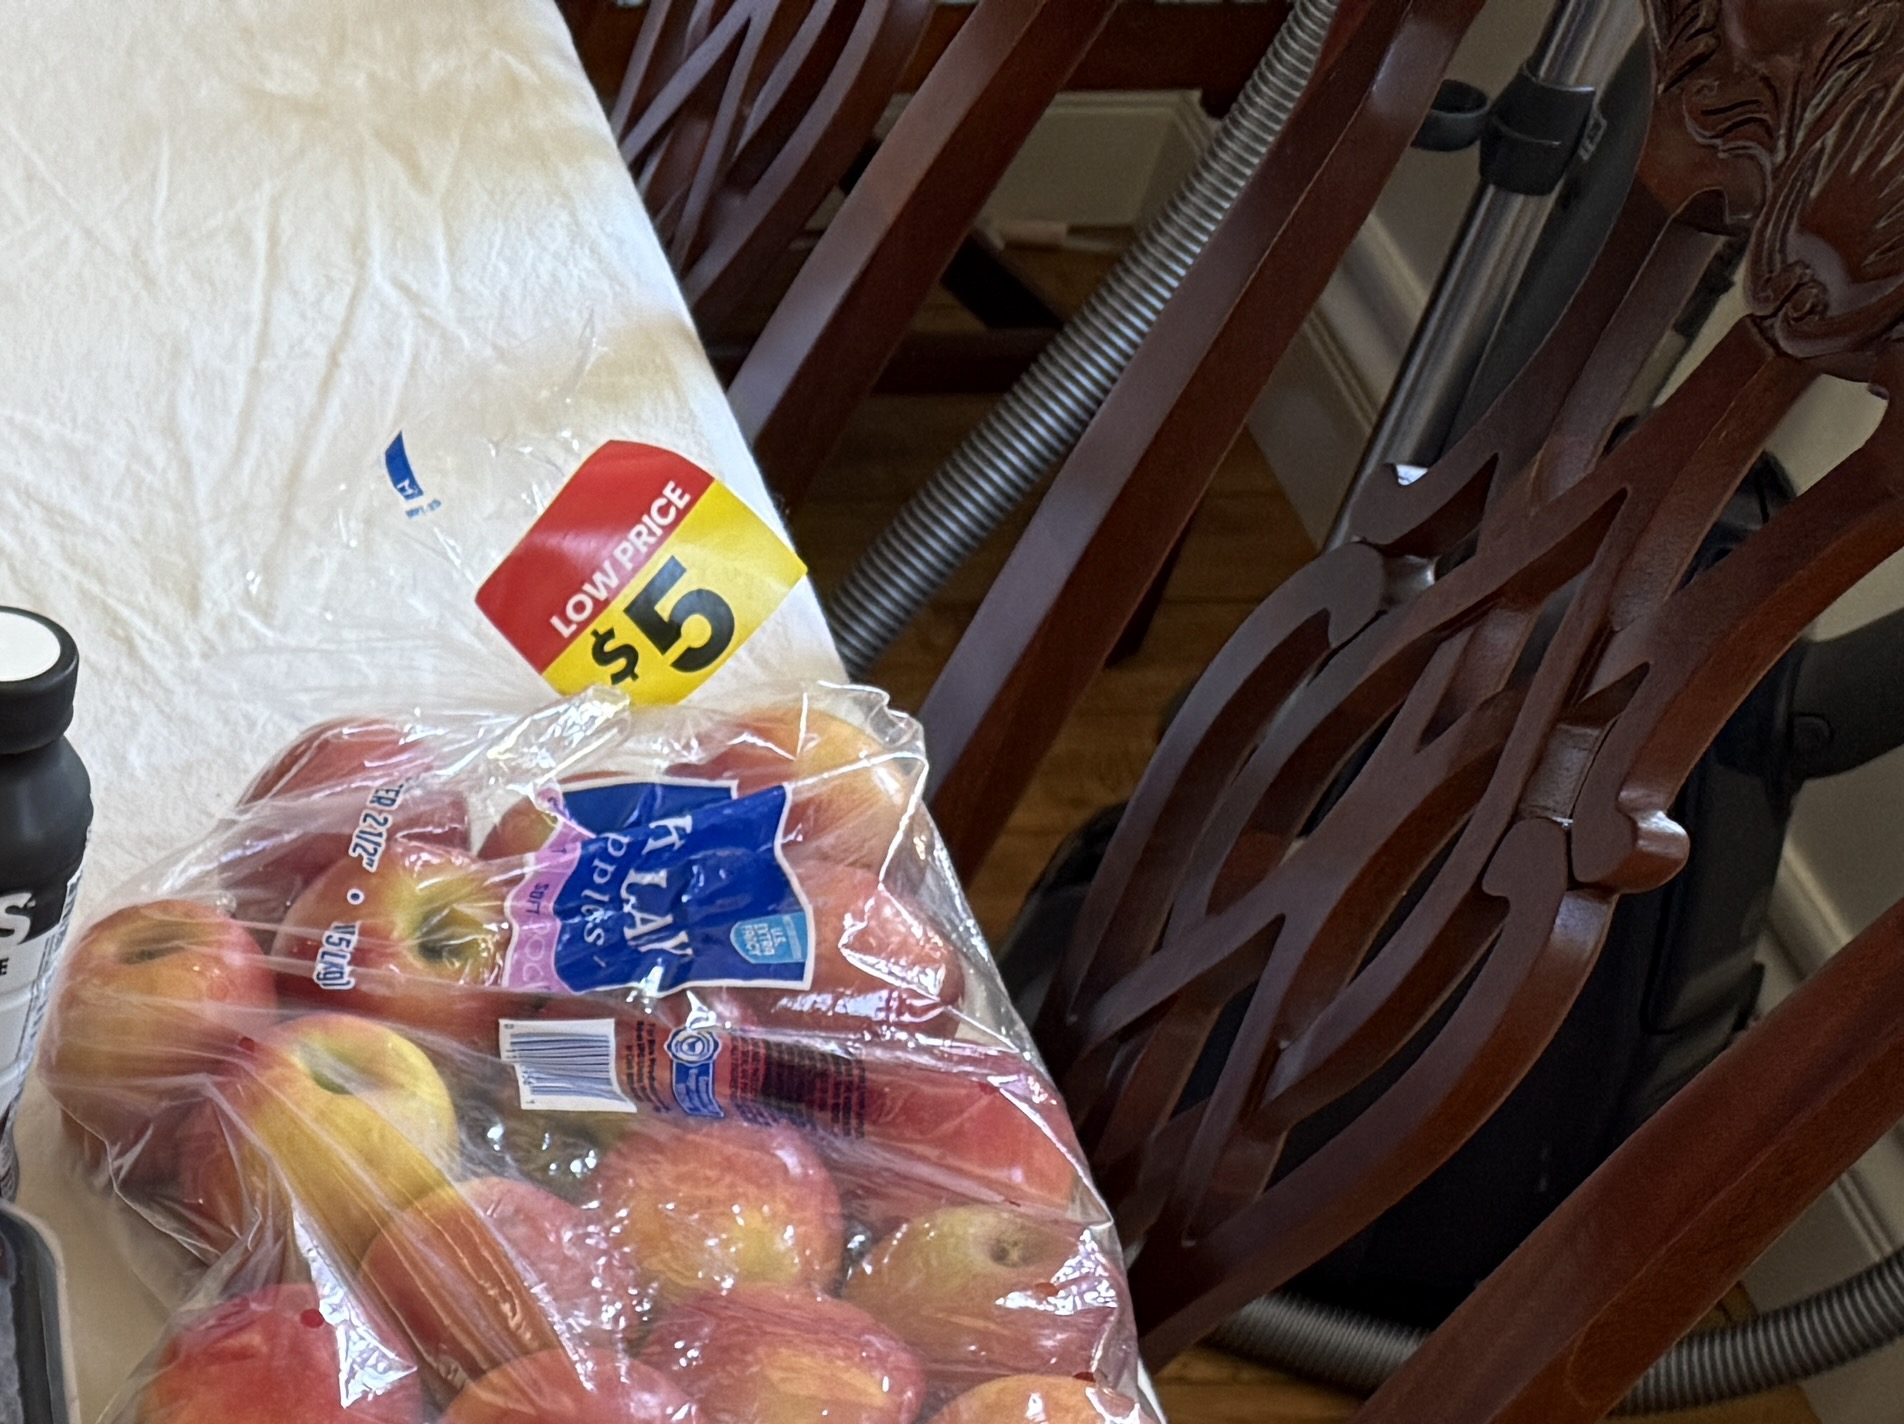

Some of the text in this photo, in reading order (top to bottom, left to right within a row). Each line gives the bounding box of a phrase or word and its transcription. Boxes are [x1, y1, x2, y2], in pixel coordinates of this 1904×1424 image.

[550, 480, 691, 639] LOW PRICE
[591, 555, 737, 685] $5
